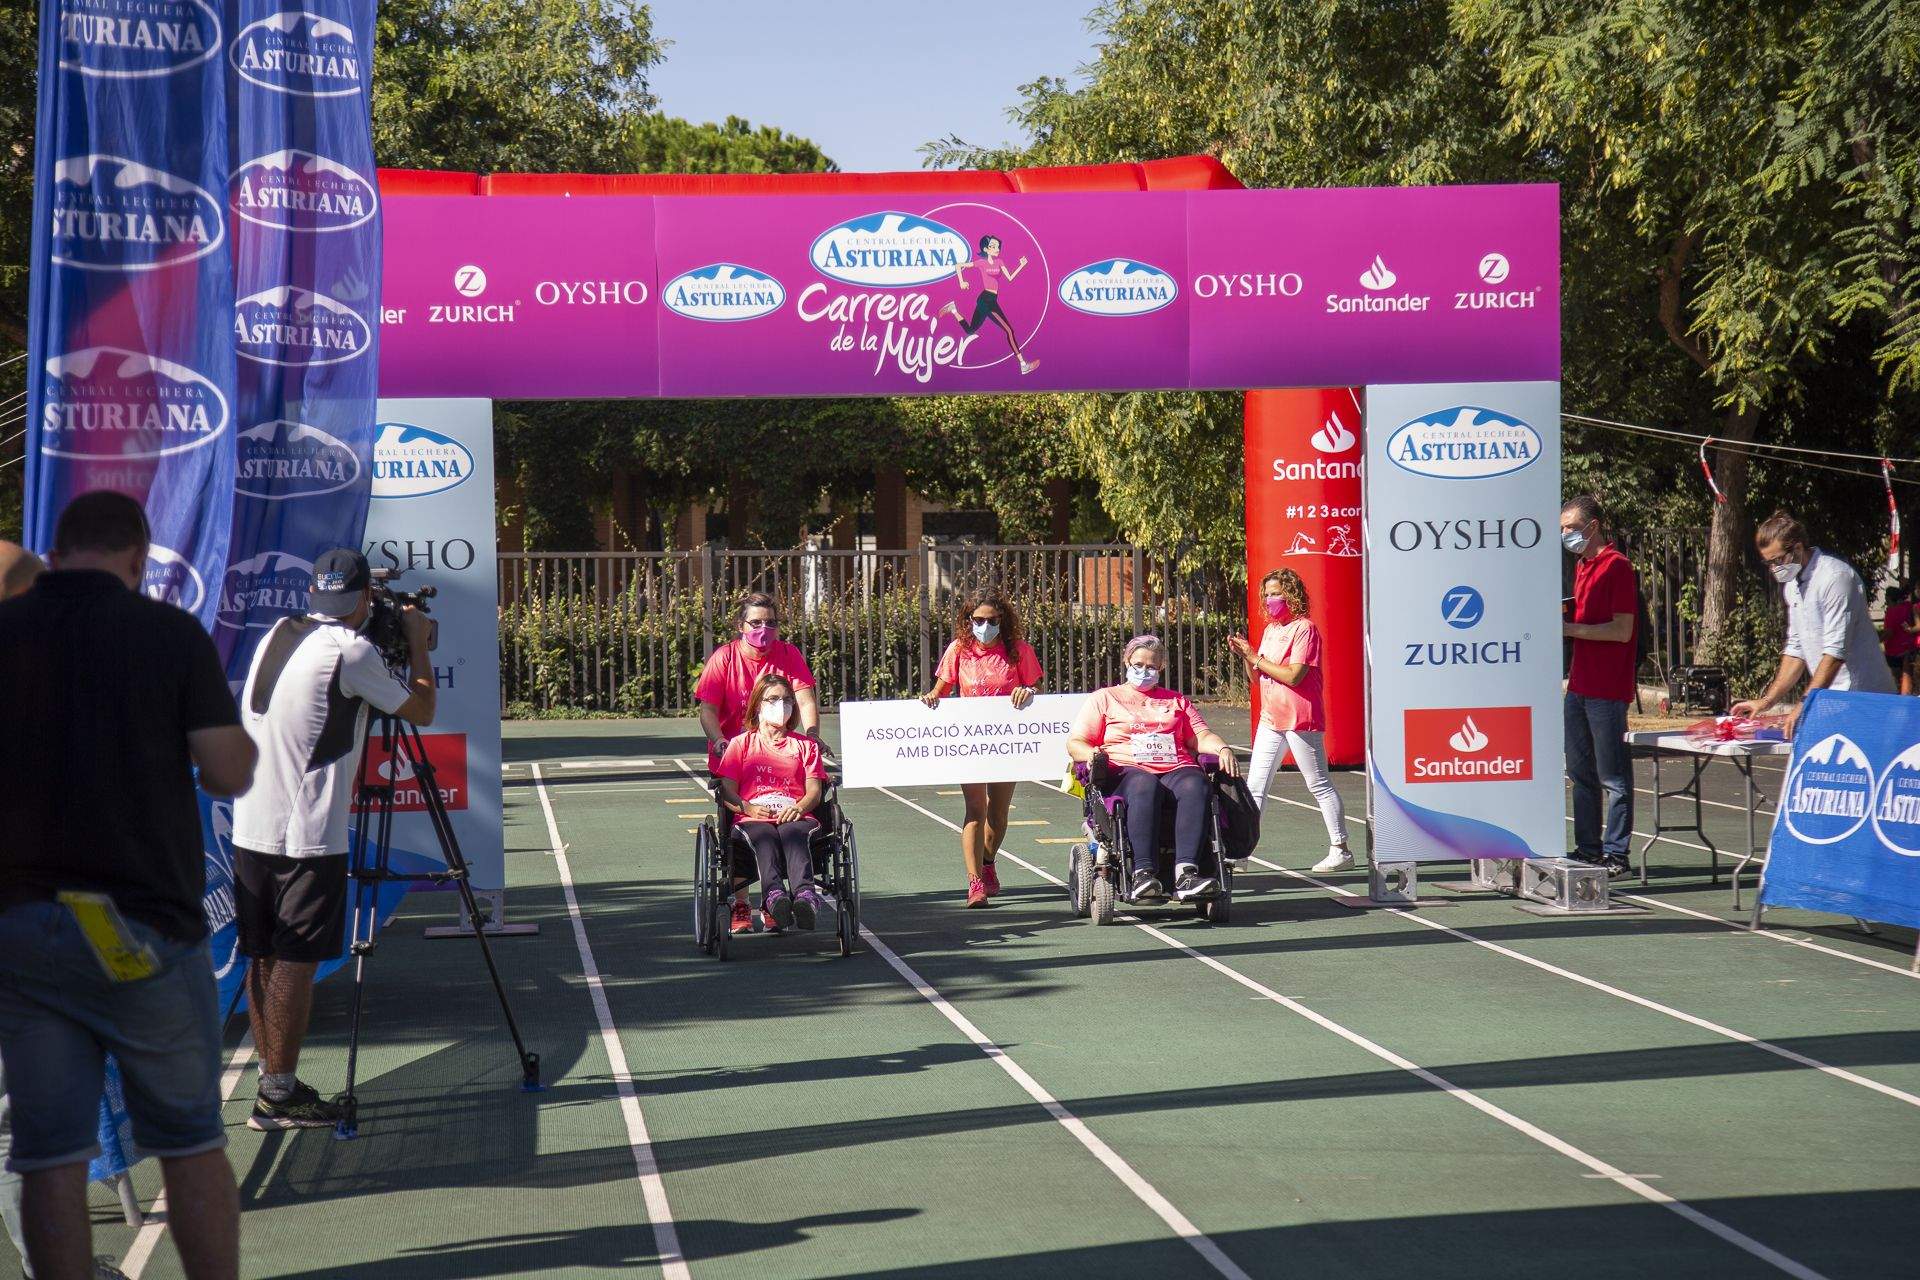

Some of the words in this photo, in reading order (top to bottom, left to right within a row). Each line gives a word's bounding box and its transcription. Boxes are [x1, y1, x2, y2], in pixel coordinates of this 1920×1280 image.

[61, 11, 203, 51] TURIANA
[240, 37, 360, 80] ASTURIAN
[847, 238, 898, 246] CENTRAL
[902, 237, 954, 245] LECHERA
[823, 239, 959, 268] ASTURIANA
[535, 280, 648, 306] OYSHO
[673, 285, 777, 307] ASTURIANA
[1067, 280, 1168, 301] ASTURIANA
[1194, 272, 1303, 298] OYSHO
[797, 282, 930, 322] Carrera
[1326, 293, 1430, 313] Santander
[1454, 291, 1535, 310] ZURICH
[429, 305, 514, 323] ZURICH
[830, 323, 855, 351] de
[860, 322, 878, 351] la
[874, 317, 980, 383] Mujer
[43, 402, 212, 433] STURIANA
[1422, 431, 1473, 440] CENTRAL
[1476, 430, 1527, 438] LECHERA
[403, 447, 457, 456] LECHERA
[1398, 434, 1532, 462] ASTURIANA
[373, 459, 463, 479] URIANA
[1389, 517, 1542, 552] OYSHO
[1404, 641, 1522, 666] ZURICH
[866, 723, 960, 741] ASSOCIACIÓ
[964, 723, 1014, 738] XARXA
[1018, 721, 1071, 736] DONES
[895, 745, 930, 759] AMB
[934, 741, 1042, 757] DISCAPACITAT
[756, 765, 773, 774] WE
[1413, 756, 1524, 777] Santander
[1790, 773, 1866, 818] ASTURIANA
[1878, 778, 1920, 824] ASTU
